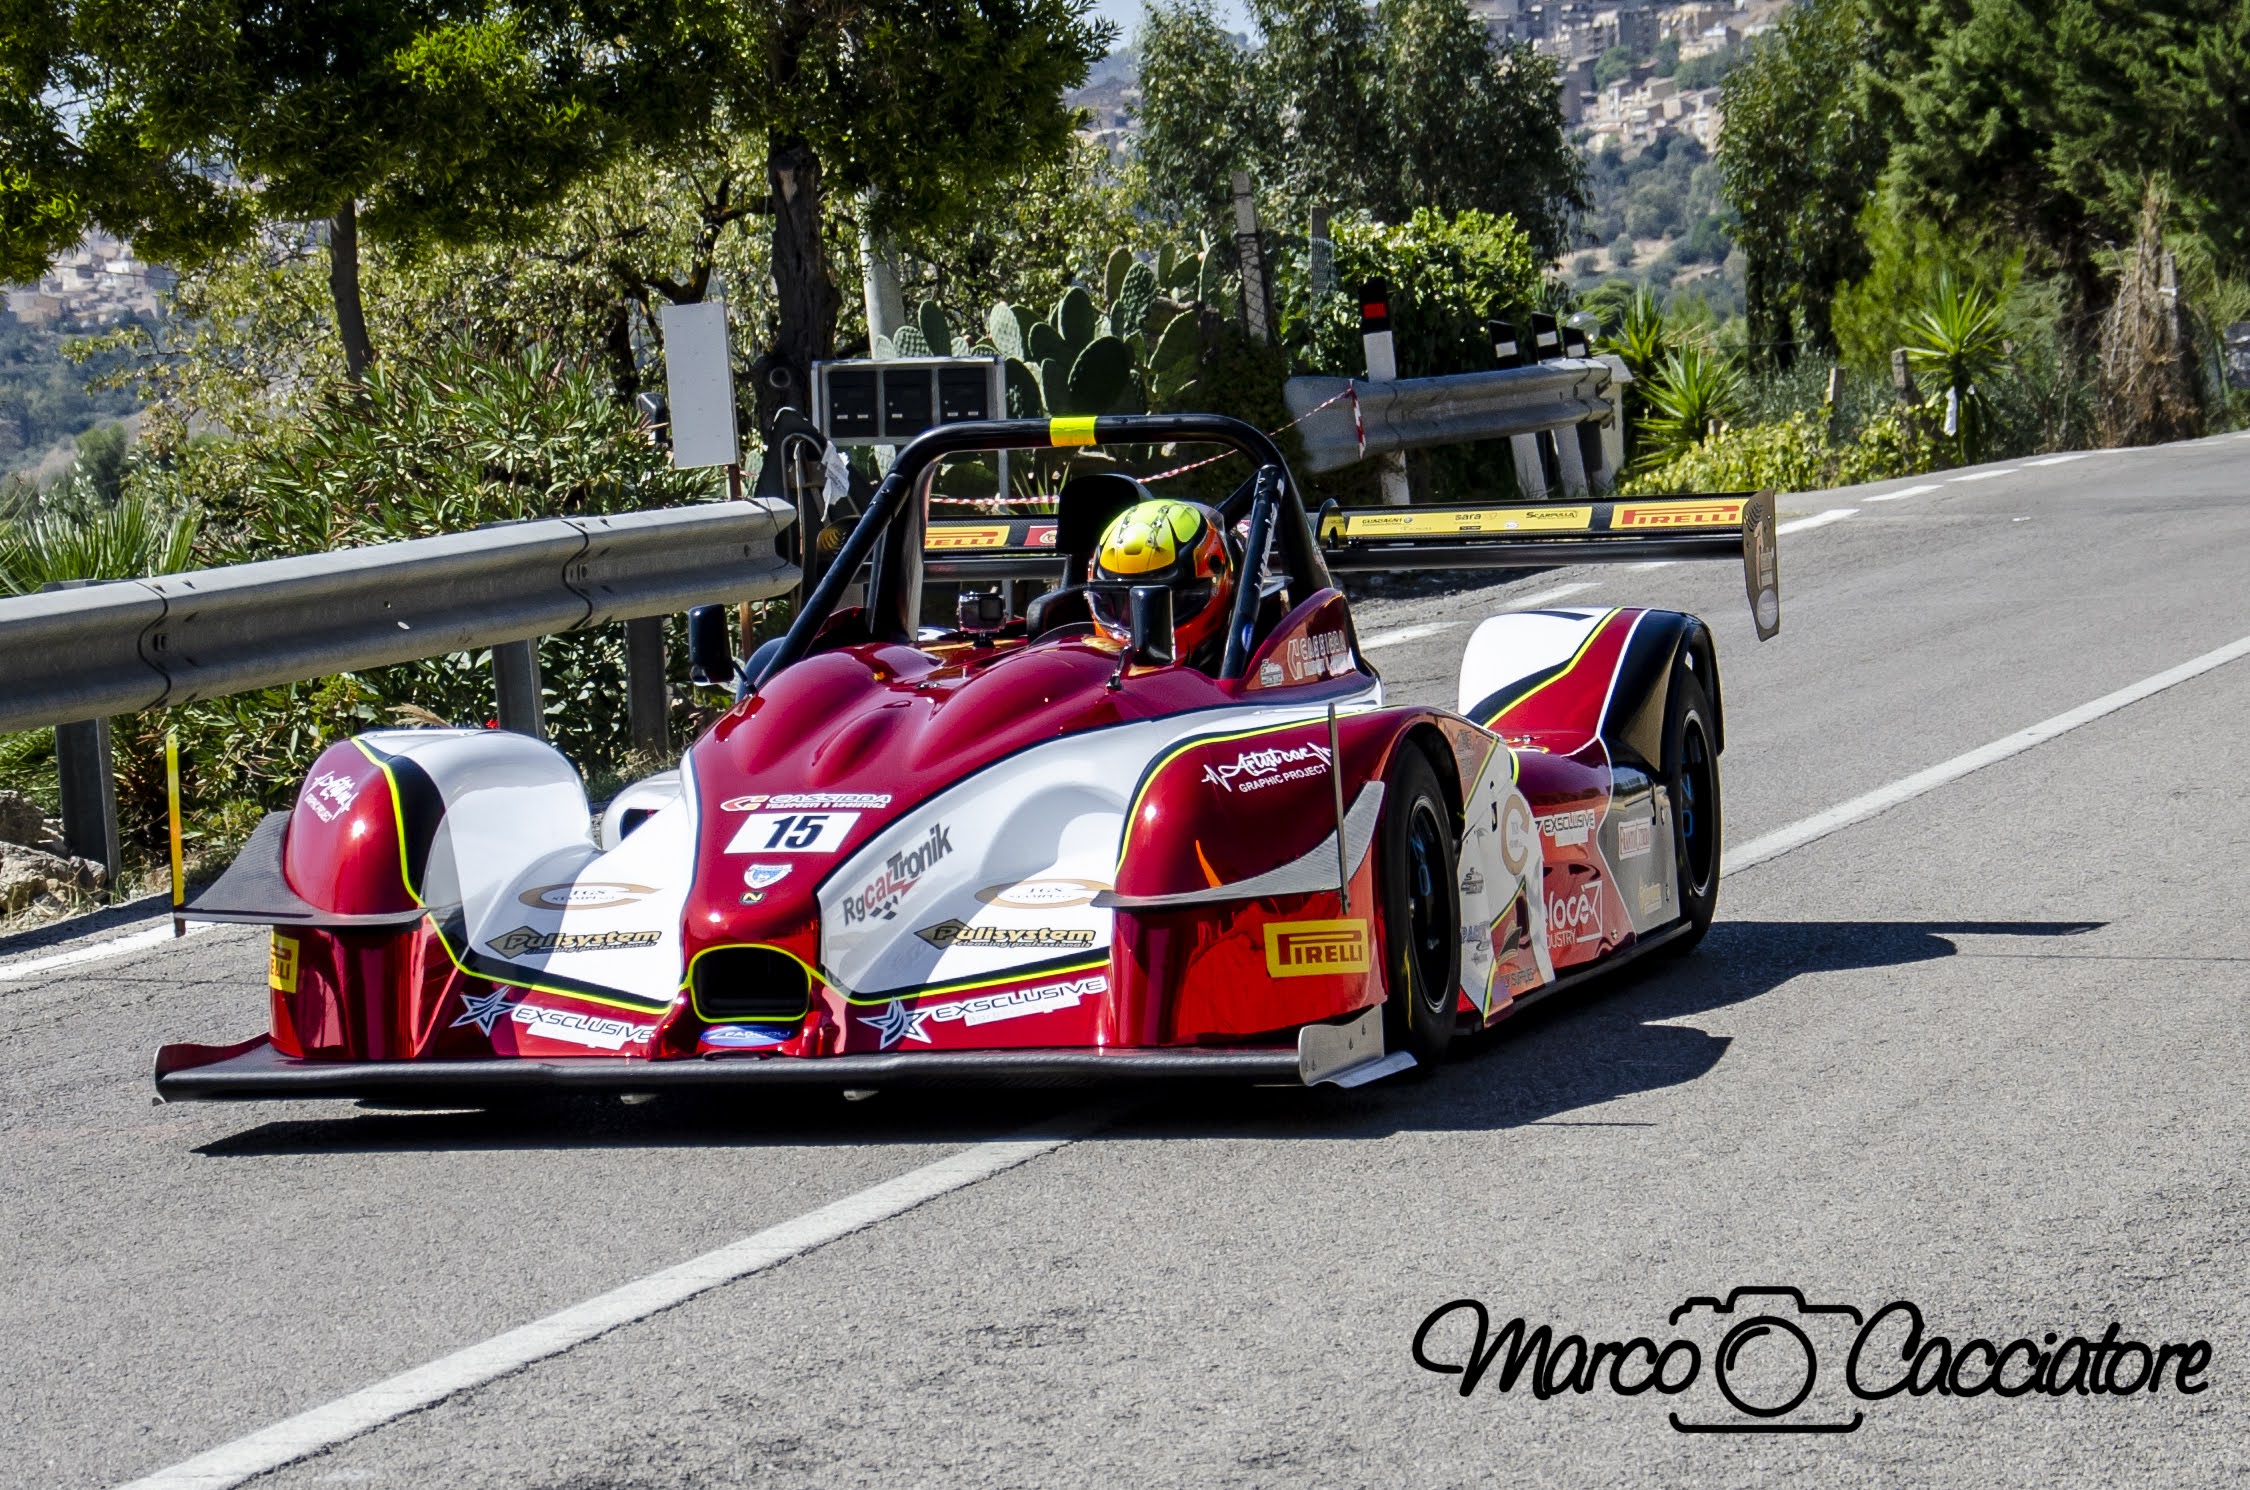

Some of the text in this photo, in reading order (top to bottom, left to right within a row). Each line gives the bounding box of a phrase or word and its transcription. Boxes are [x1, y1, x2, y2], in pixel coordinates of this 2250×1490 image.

[1621, 505, 1740, 525] PIRELLI
[1238, 763, 1327, 793] GRAPHIC PROJECT
[764, 815, 831, 849] 15
[1544, 811, 1595, 834] EXSCLUSIVE
[503, 930, 662, 950] Pullsystem
[934, 925, 1096, 944] Pullsystem
[1277, 930, 1363, 966] PIRELLI
[935, 979, 1104, 1019] EXSCLUSIVE
[514, 1007, 656, 1041] EXSCLUSIVE
